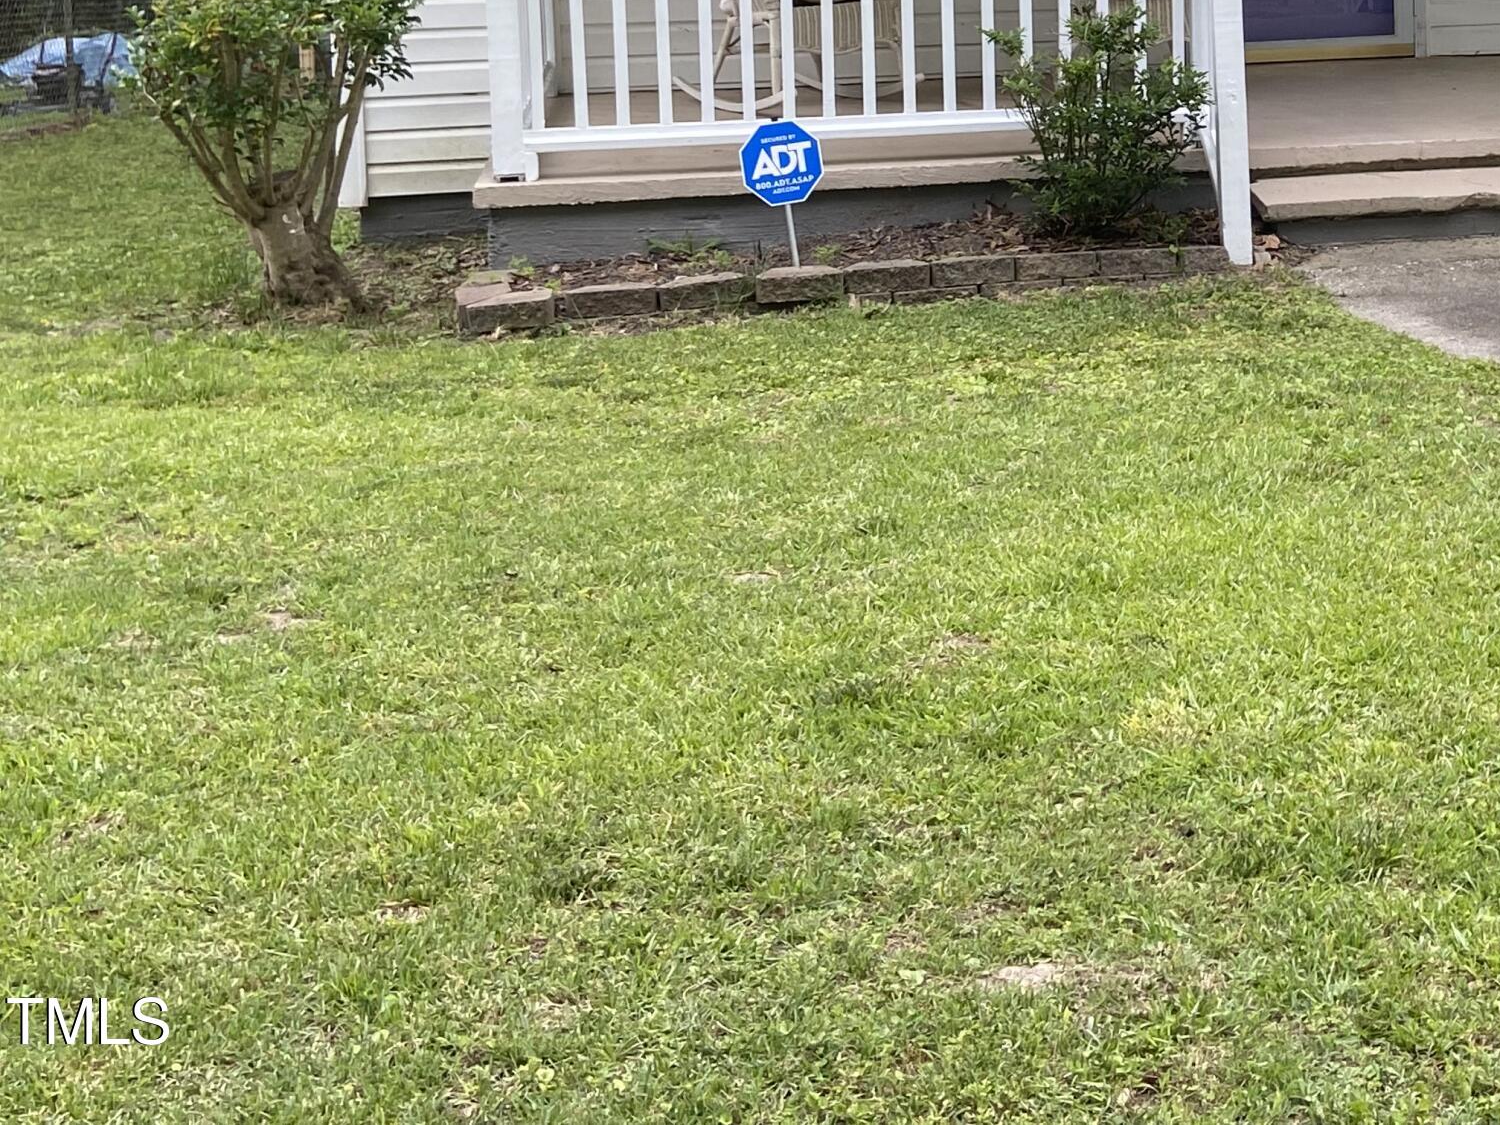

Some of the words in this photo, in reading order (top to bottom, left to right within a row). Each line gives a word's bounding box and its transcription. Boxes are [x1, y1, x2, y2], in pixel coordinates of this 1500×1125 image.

[761, 135, 788, 144] SECURED
[752, 141, 812, 180] ADT
[756, 174, 815, 190] 800.ADT.ASAP
[772, 186, 801, 195] ADT.COM
